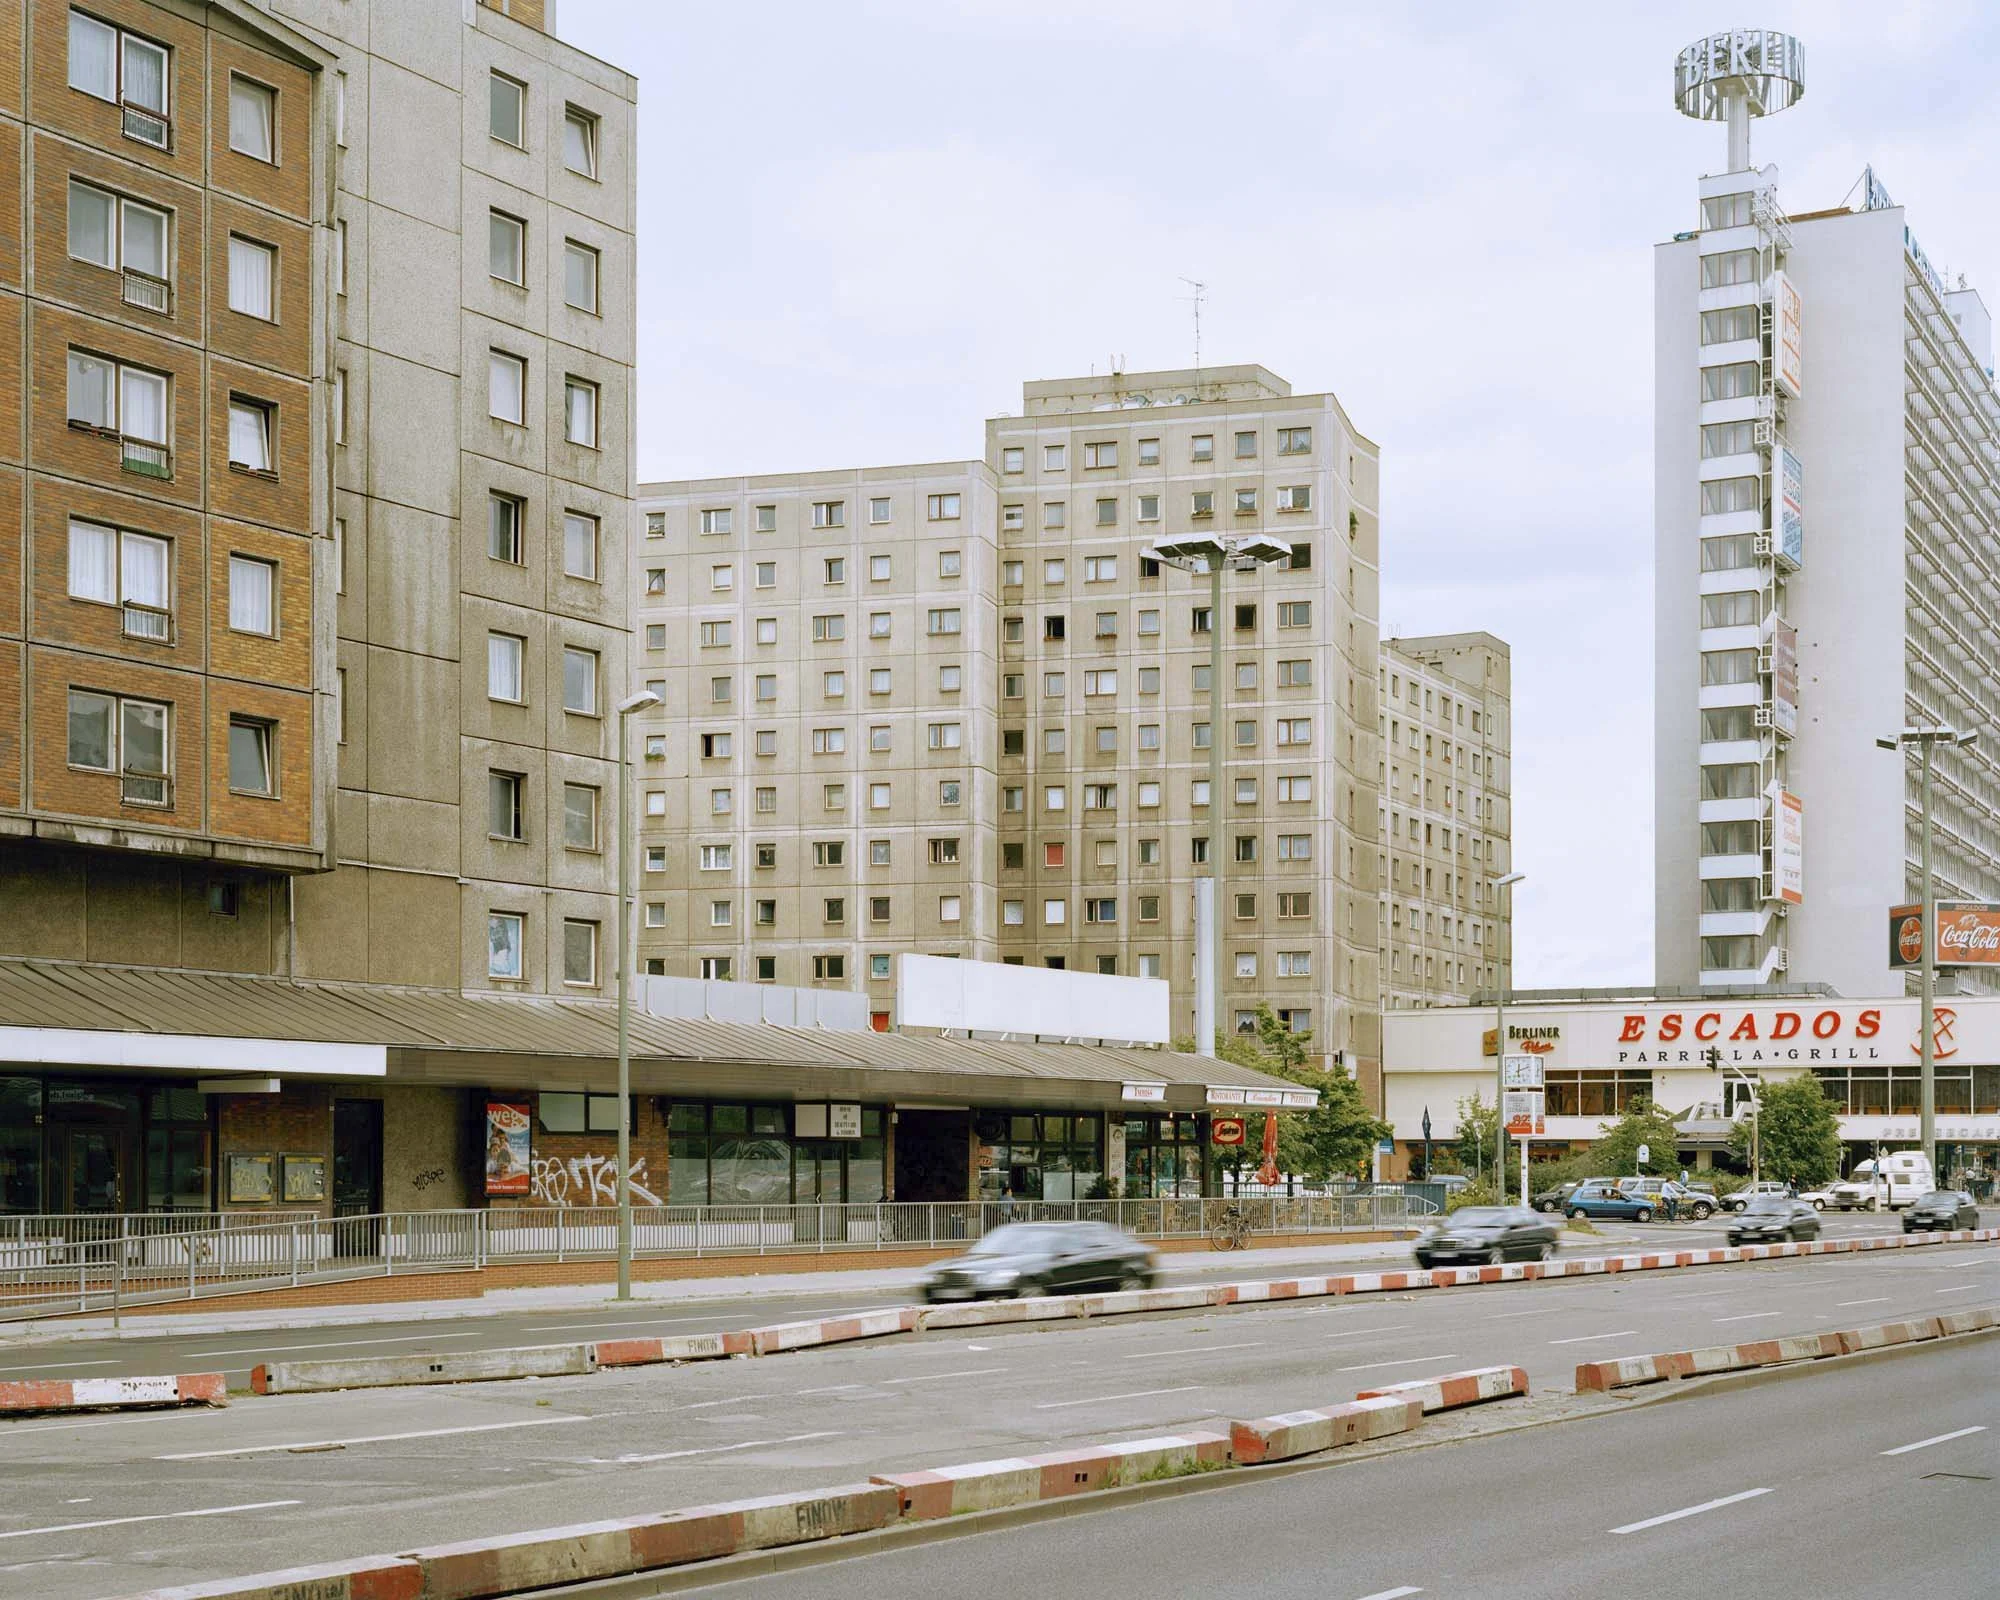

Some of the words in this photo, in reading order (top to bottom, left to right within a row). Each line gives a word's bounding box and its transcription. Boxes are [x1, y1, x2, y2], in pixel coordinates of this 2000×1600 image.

[1508, 1025, 1561, 1040] BERLINER
[1618, 1010, 1881, 1042] ESCADOS
[1788, 1047, 1879, 1060] GRILL
[688, 1338, 718, 1353] FINOW
